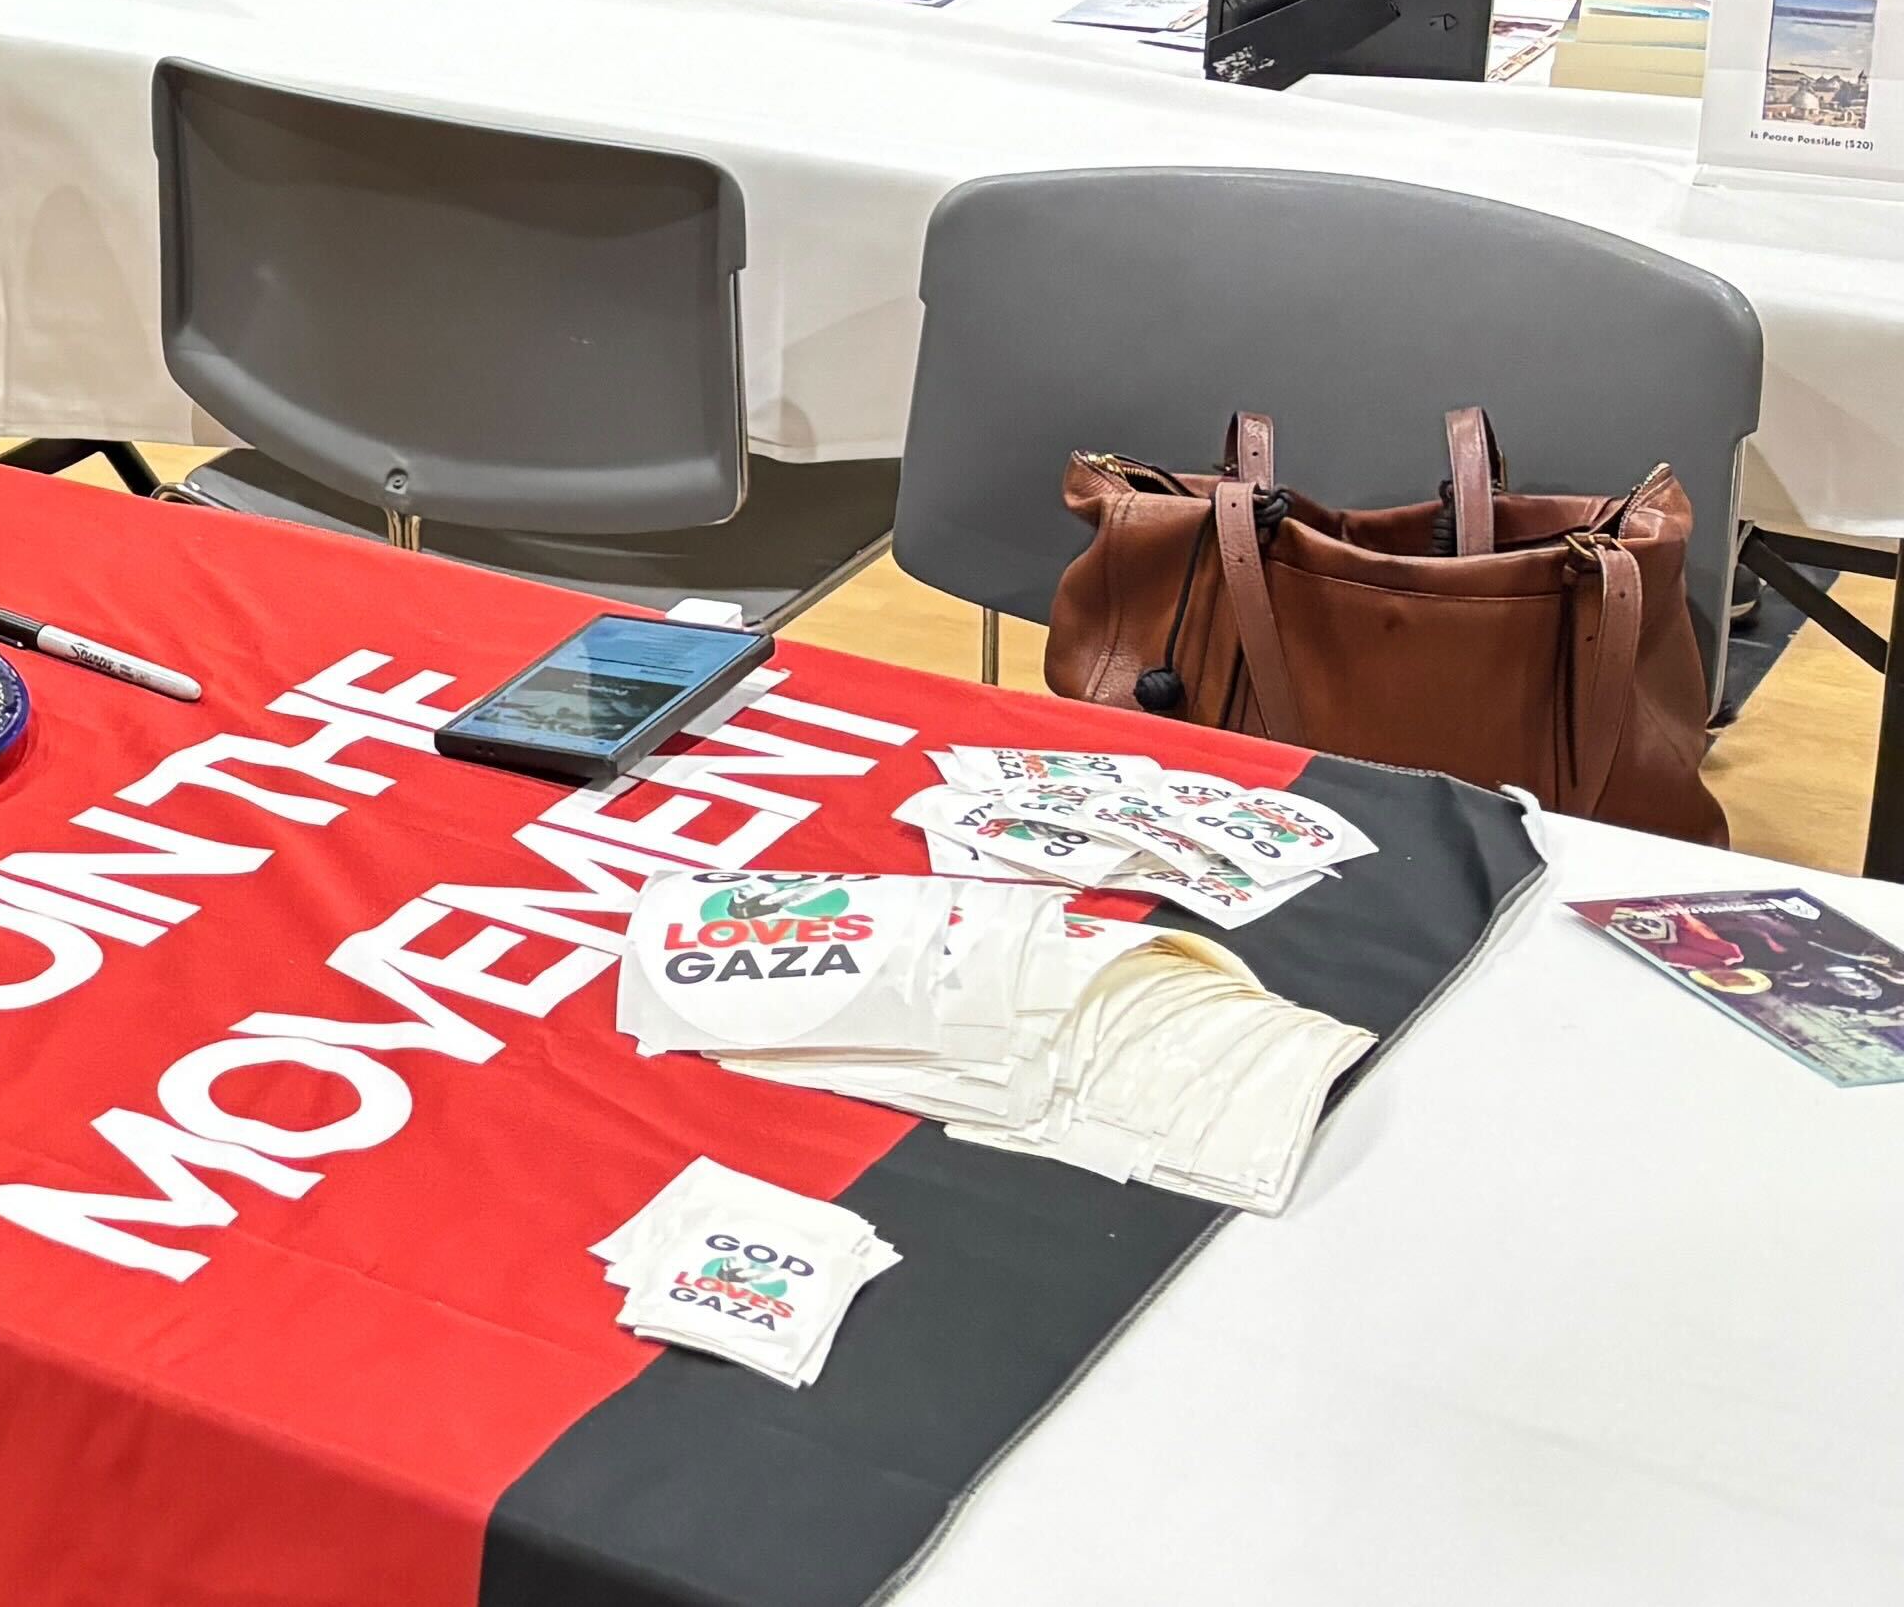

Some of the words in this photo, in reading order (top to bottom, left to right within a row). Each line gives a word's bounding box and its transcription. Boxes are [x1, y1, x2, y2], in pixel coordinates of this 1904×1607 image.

[1797, 135, 1841, 148] Possible
[126, 646, 481, 827] THE
[1196, 814, 1284, 860] GOD
[662, 914, 875, 952] LOVES
[664, 942, 862, 985] GAZA
[704, 1233, 816, 1278] GOD
[668, 1286, 777, 1332] GAZA
[672, 1270, 797, 1319] LOVES
